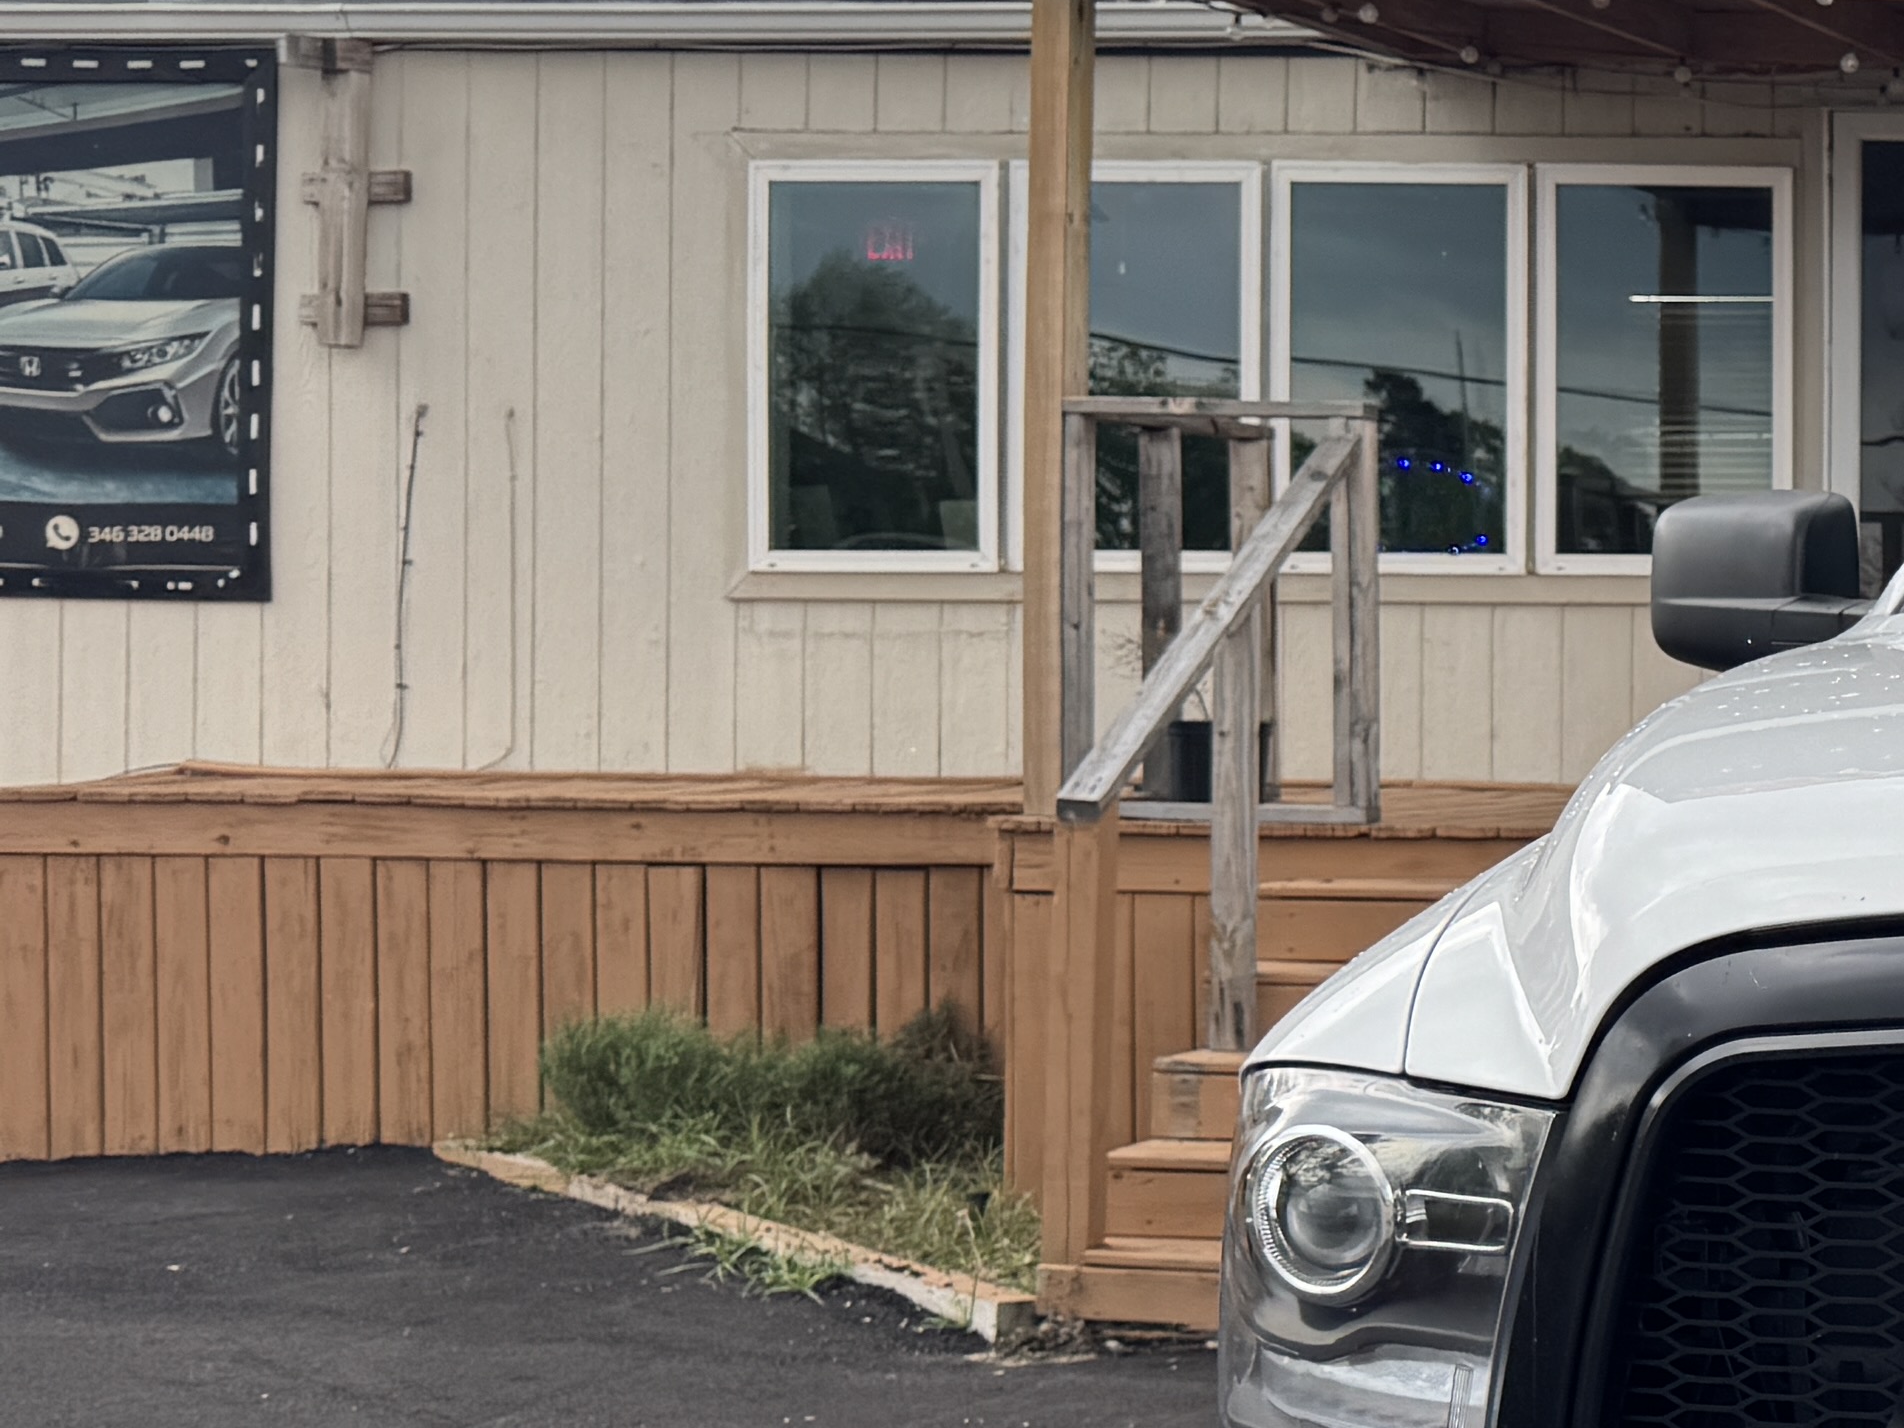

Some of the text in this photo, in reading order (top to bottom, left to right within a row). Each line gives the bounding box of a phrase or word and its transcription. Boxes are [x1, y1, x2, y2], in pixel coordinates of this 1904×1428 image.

[88, 525, 214, 543] 346 328 0448
